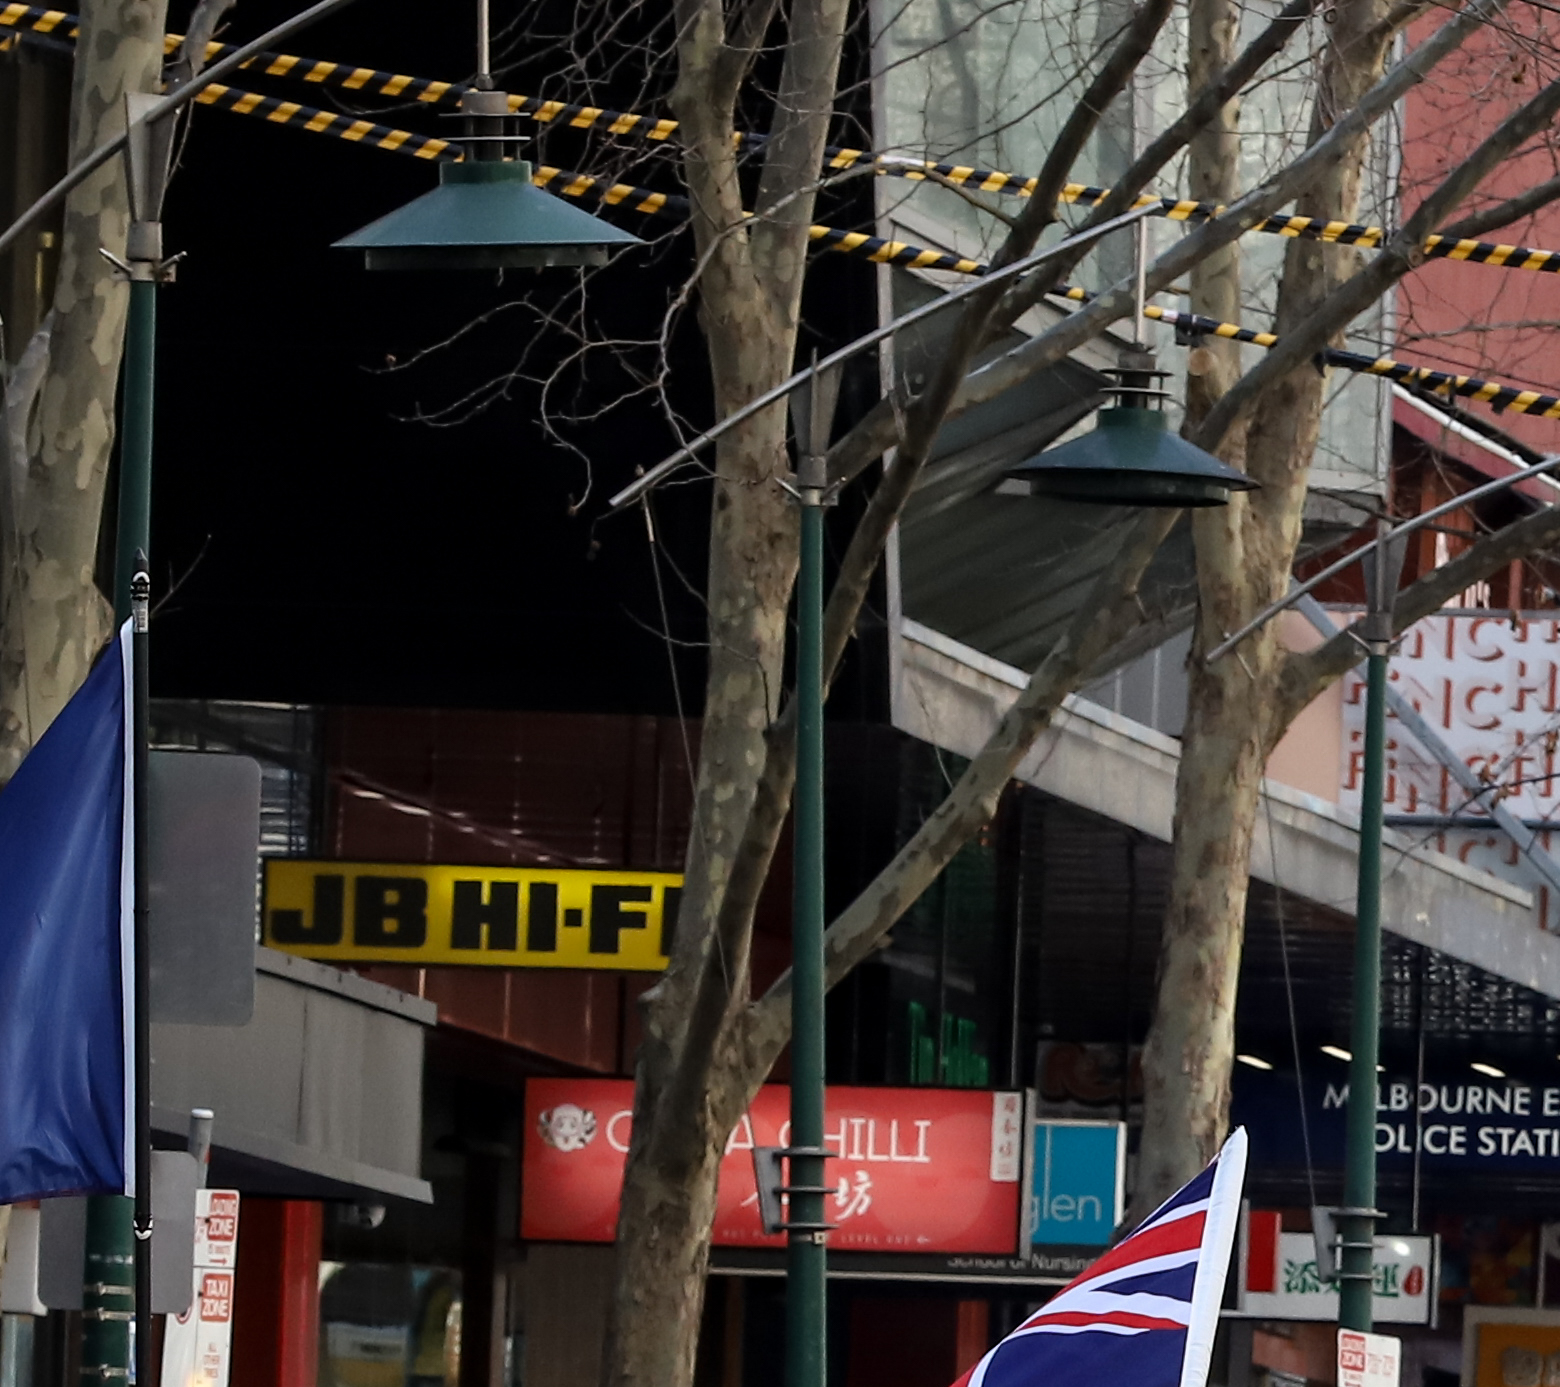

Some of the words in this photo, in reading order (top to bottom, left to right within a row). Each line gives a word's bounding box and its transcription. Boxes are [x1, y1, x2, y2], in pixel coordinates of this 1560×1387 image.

[269, 874, 428, 950] JB
[1323, 1083, 1530, 1117] MLBOURNE
[1374, 1123, 1466, 1156] OLICE
[208, 1218, 234, 1236] ZONE
[205, 1279, 228, 1297] TAXI
[202, 1299, 228, 1317] ZONE
